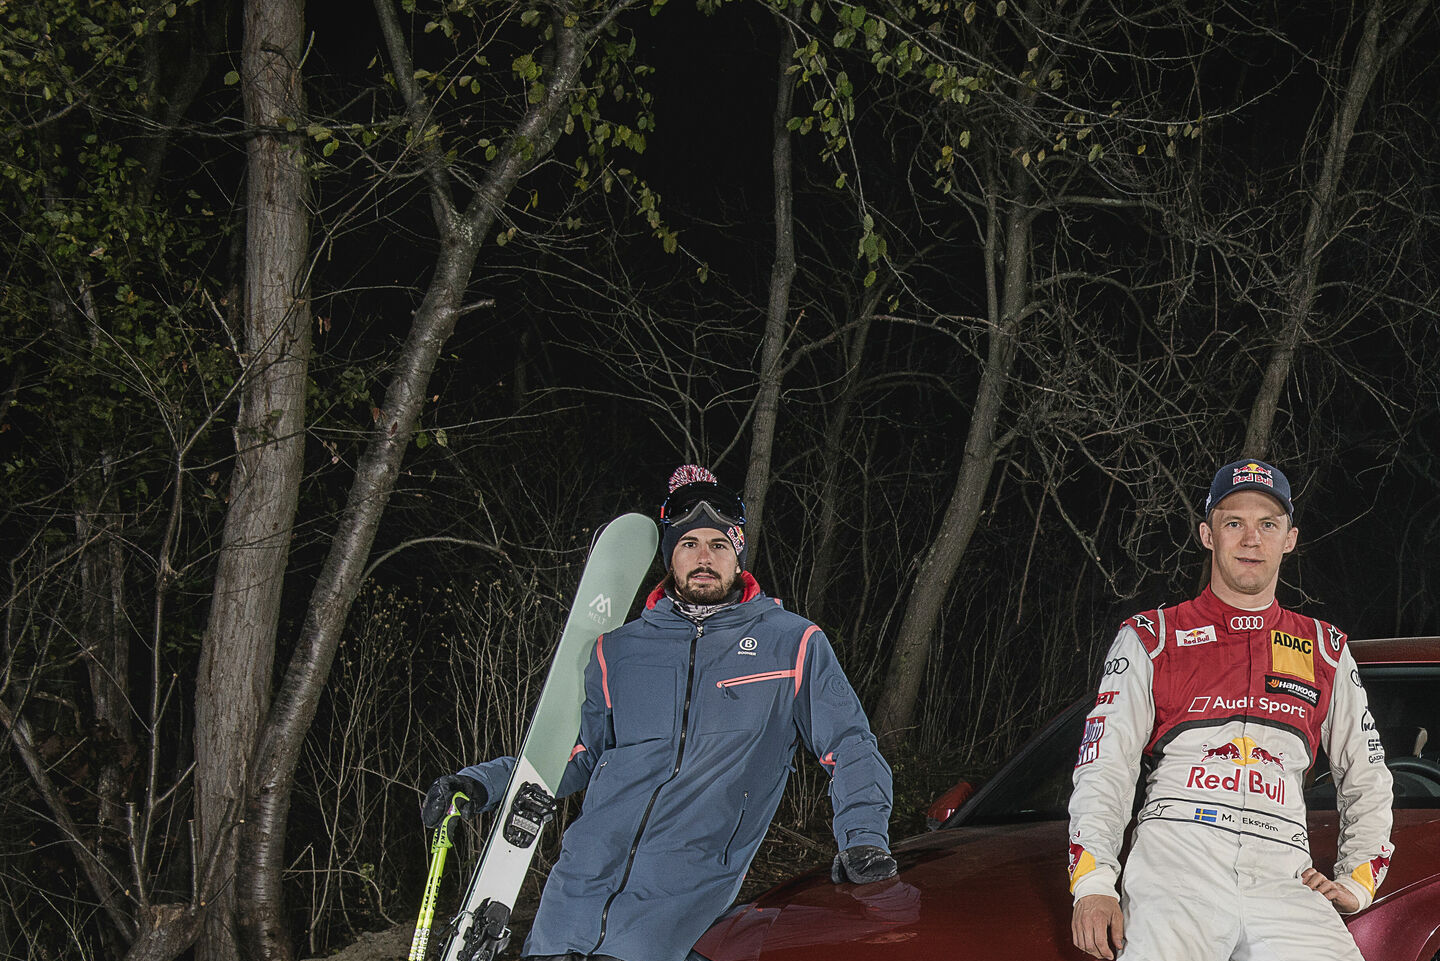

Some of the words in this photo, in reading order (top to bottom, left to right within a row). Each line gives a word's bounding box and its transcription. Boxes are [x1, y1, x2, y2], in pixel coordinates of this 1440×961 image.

[1233, 473, 1253, 486] Red
[1255, 474, 1273, 488] Bull
[1183, 637, 1197, 645] Red
[1197, 635, 1210, 643] Bull
[1274, 632, 1312, 654] ADAC
[1213, 696, 1254, 709] Audi
[1258, 697, 1306, 719] Sport
[1186, 766, 1242, 792] Red
[1248, 769, 1285, 805] Bull
[1221, 813, 1235, 823] M.
[1242, 817, 1279, 832] Ekström
